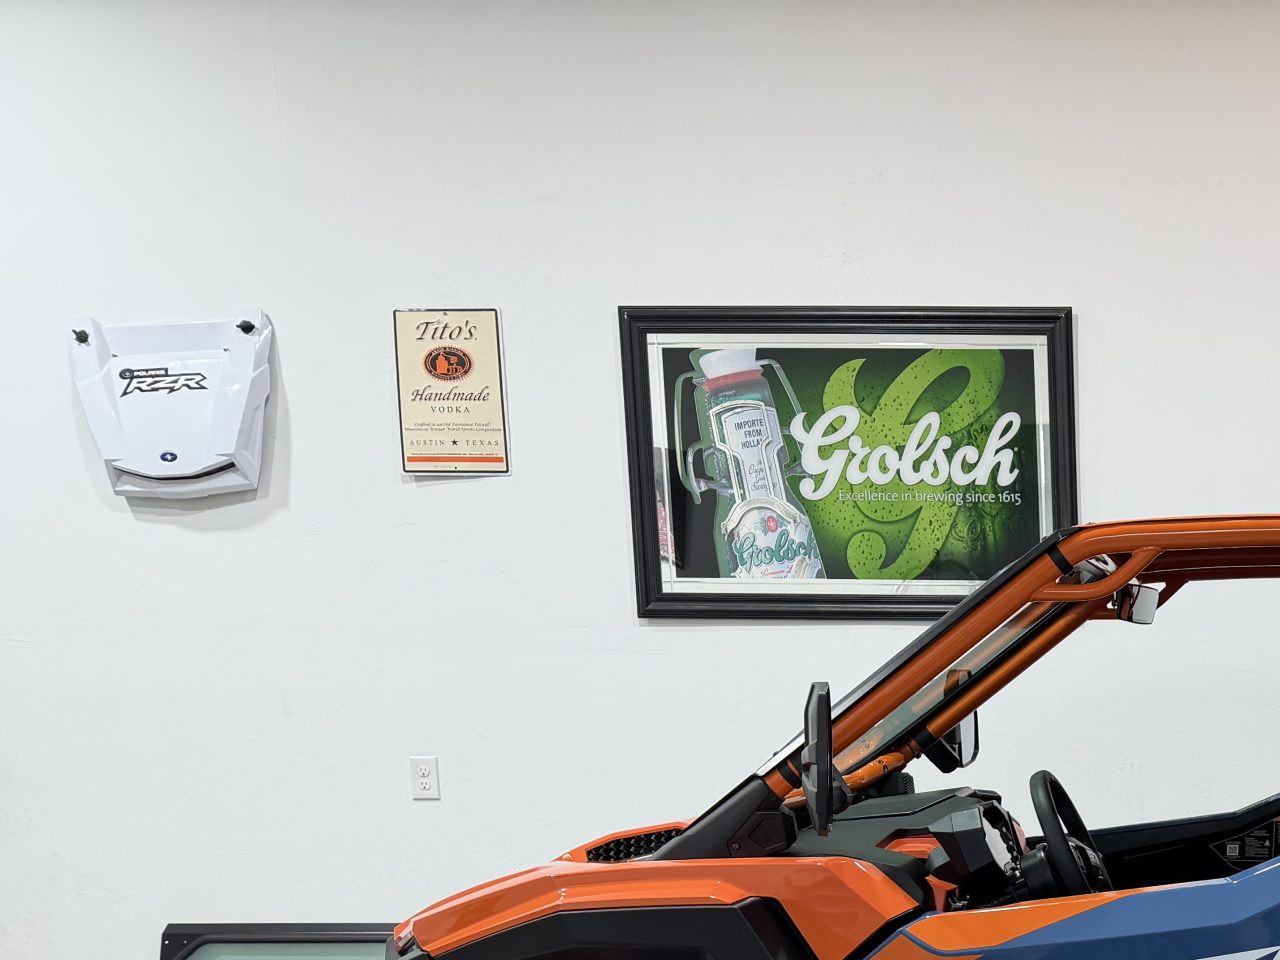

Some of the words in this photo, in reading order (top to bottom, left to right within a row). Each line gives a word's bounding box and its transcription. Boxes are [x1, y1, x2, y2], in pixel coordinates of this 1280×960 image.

[121, 373, 207, 397] RZR
[410, 385, 490, 402] Handmade
[430, 406, 470, 414] VODKA
[734, 418, 764, 431] IMPORTE
[744, 428, 763, 439] FROM
[741, 439, 763, 449] HOLLA
[789, 404, 1022, 501] Grolsch
[838, 490, 899, 501] Excellence
[901, 490, 912, 501] in
[915, 490, 964, 506] brewing
[965, 491, 996, 503] since
[999, 491, 1022, 506] 1615
[733, 528, 820, 574] Grolsch
